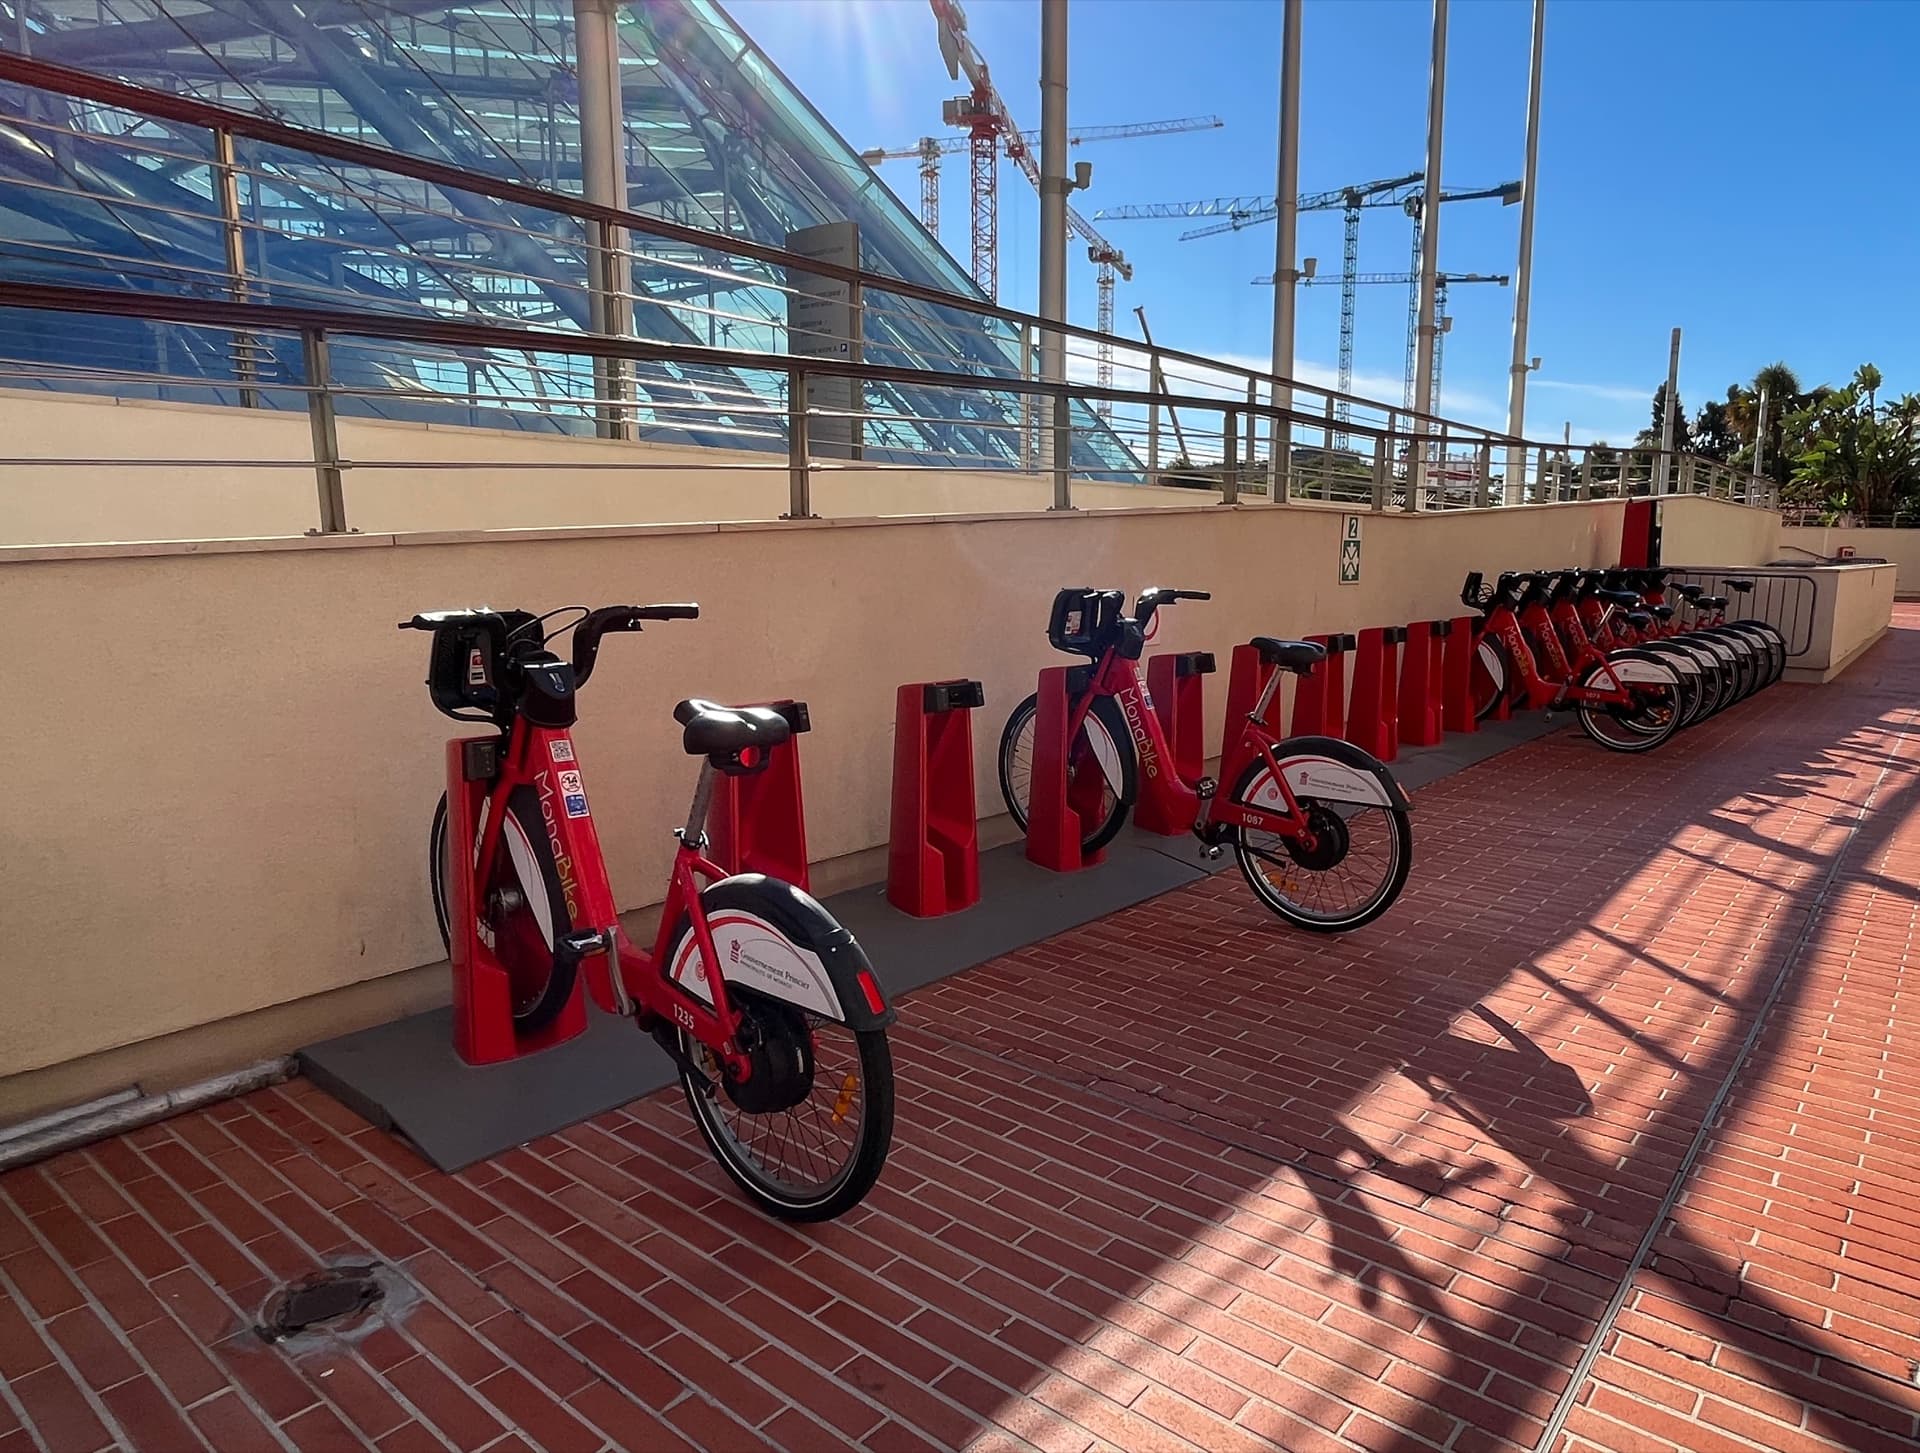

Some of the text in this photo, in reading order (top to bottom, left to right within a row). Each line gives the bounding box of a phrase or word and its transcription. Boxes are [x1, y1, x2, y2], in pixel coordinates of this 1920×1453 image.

[1350, 519, 1357, 537] 2
[1120, 687, 1158, 779] MonaBike
[1241, 812, 1264, 826] 1087
[534, 769, 579, 921] MonaBike
[673, 1003, 695, 1030] 1235
